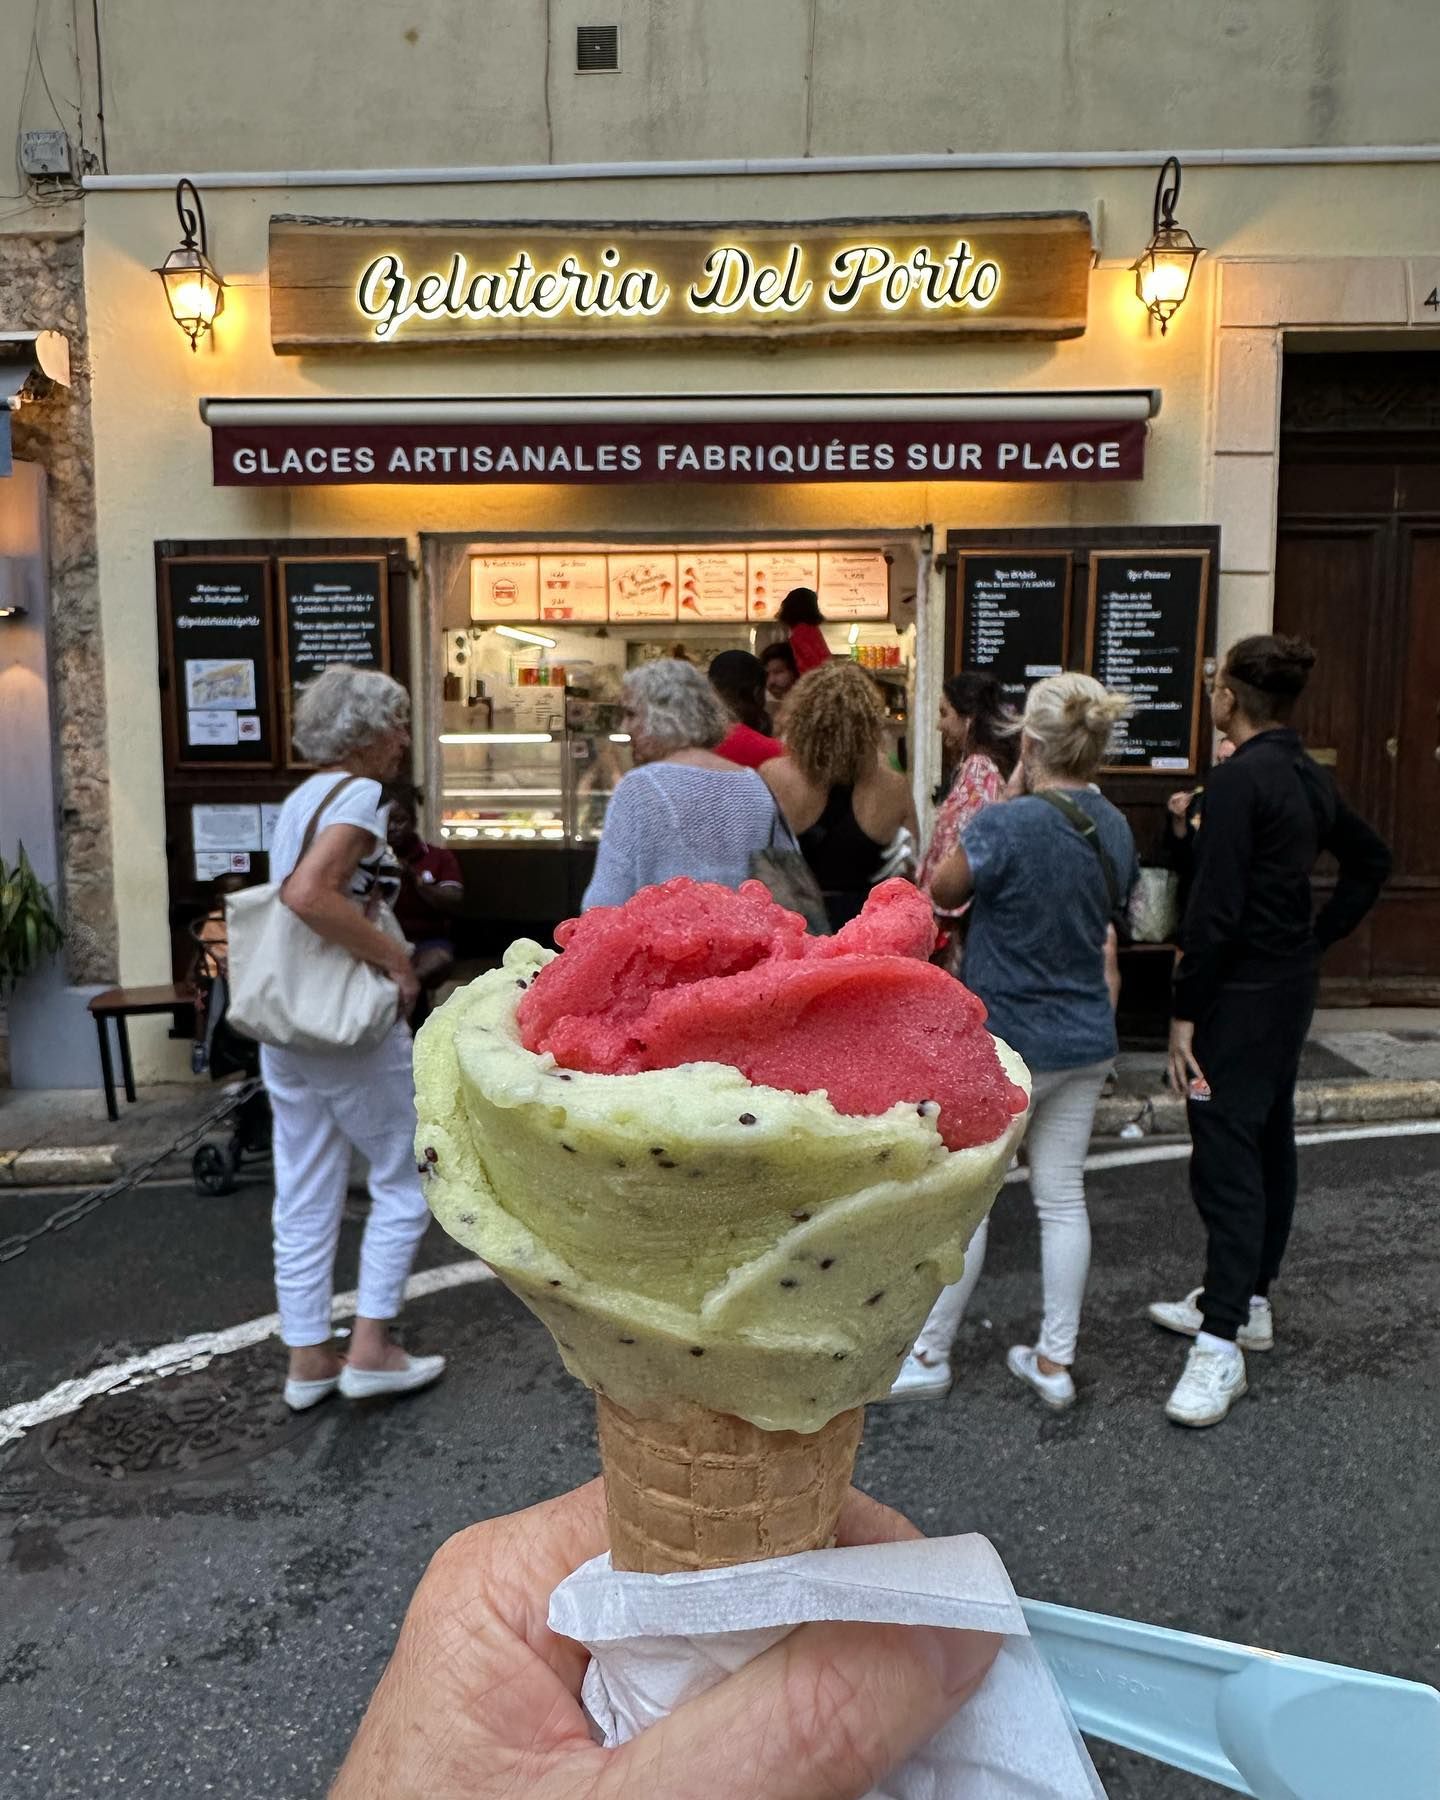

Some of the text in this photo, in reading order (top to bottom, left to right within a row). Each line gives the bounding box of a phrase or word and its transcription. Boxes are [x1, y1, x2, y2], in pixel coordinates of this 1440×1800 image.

[358, 240, 999, 343] Gelateria Del Porto
[233, 439, 1120, 474] GLACES ARTISANALES FABRIQUÉES SUR PLACE
